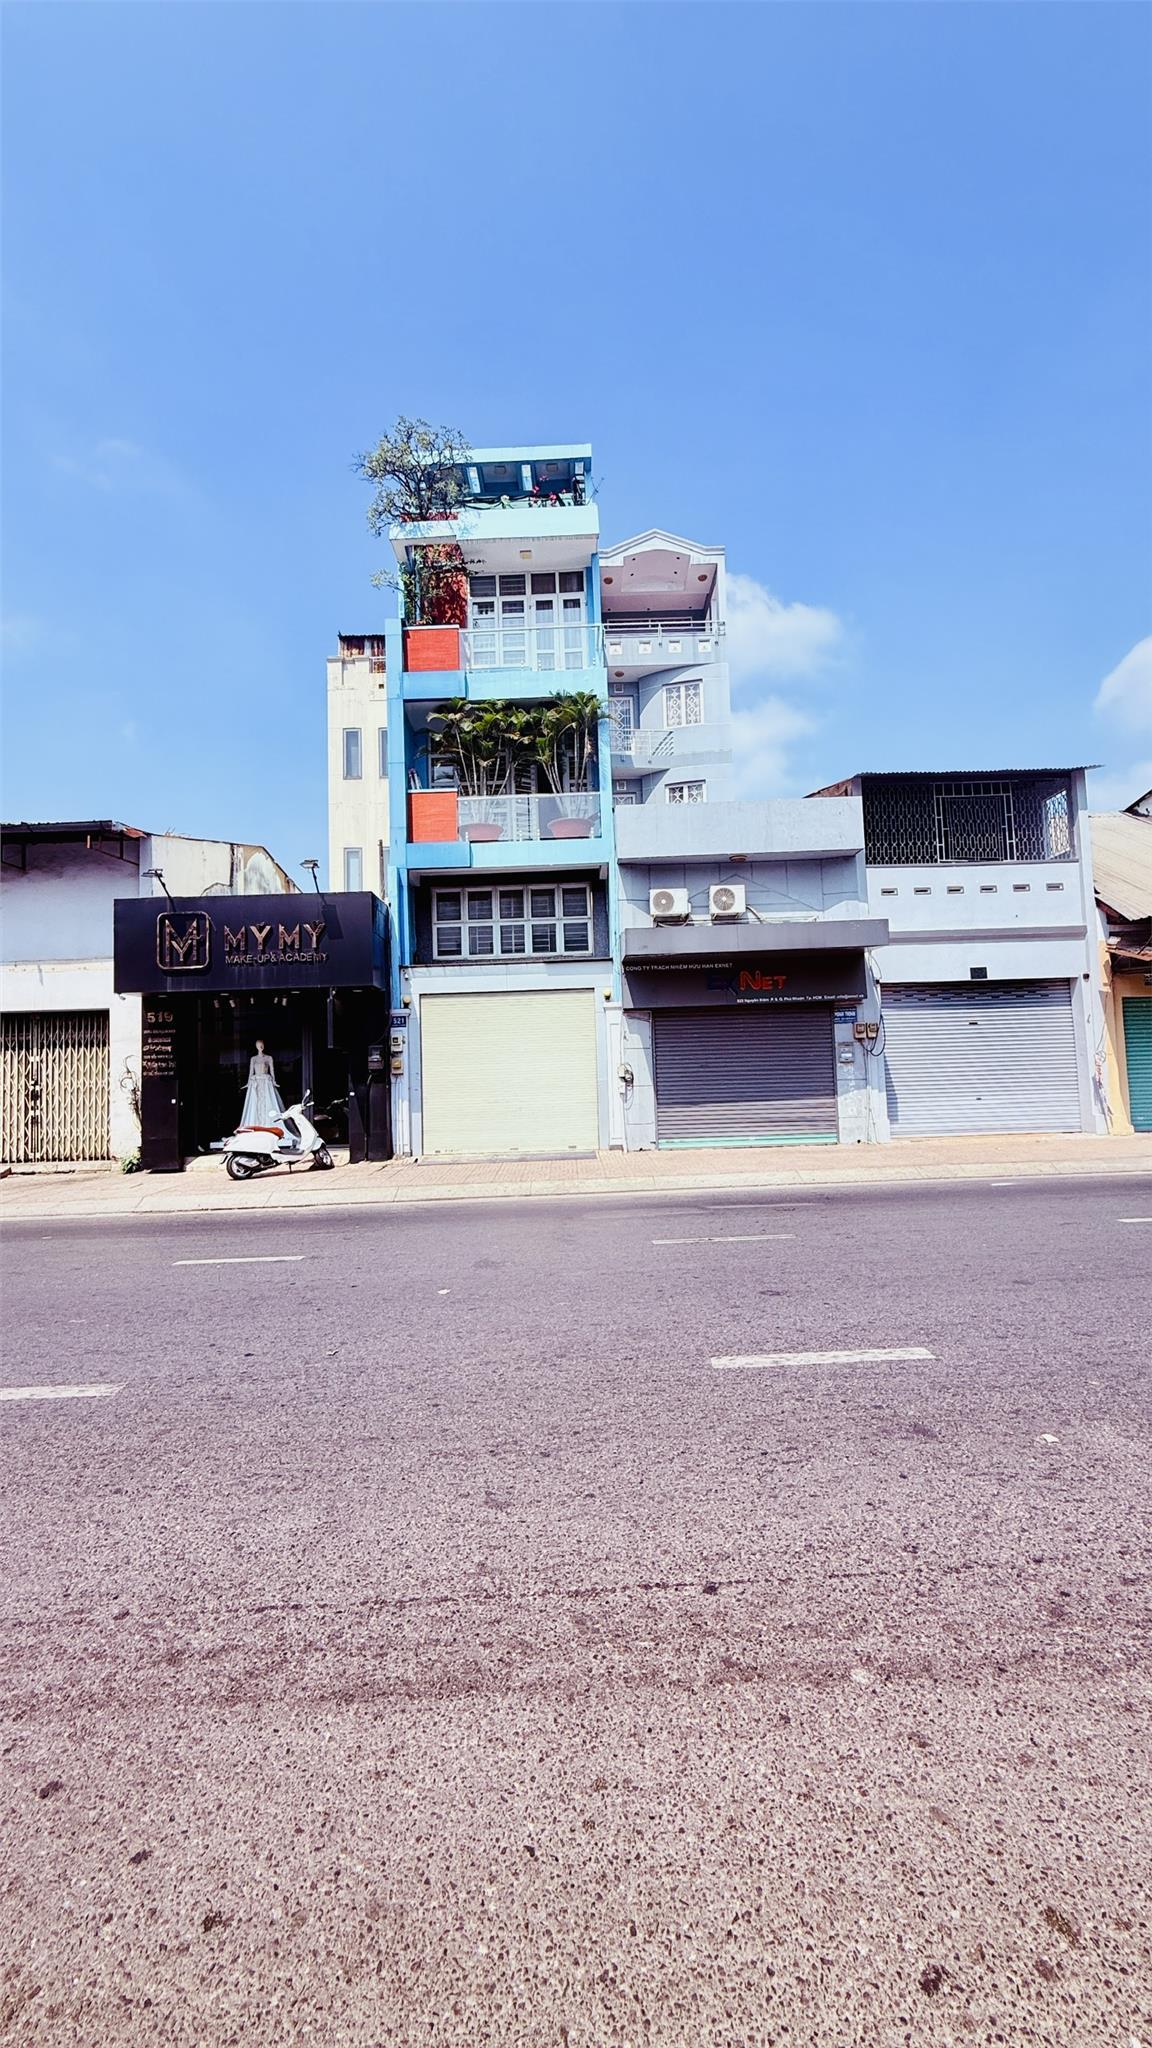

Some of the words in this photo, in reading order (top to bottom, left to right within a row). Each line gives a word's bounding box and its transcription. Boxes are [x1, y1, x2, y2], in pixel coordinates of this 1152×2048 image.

[279, 952, 328, 962] ACADEMY
[147, 1011, 174, 1023] 519
[393, 1017, 405, 1025] 521
